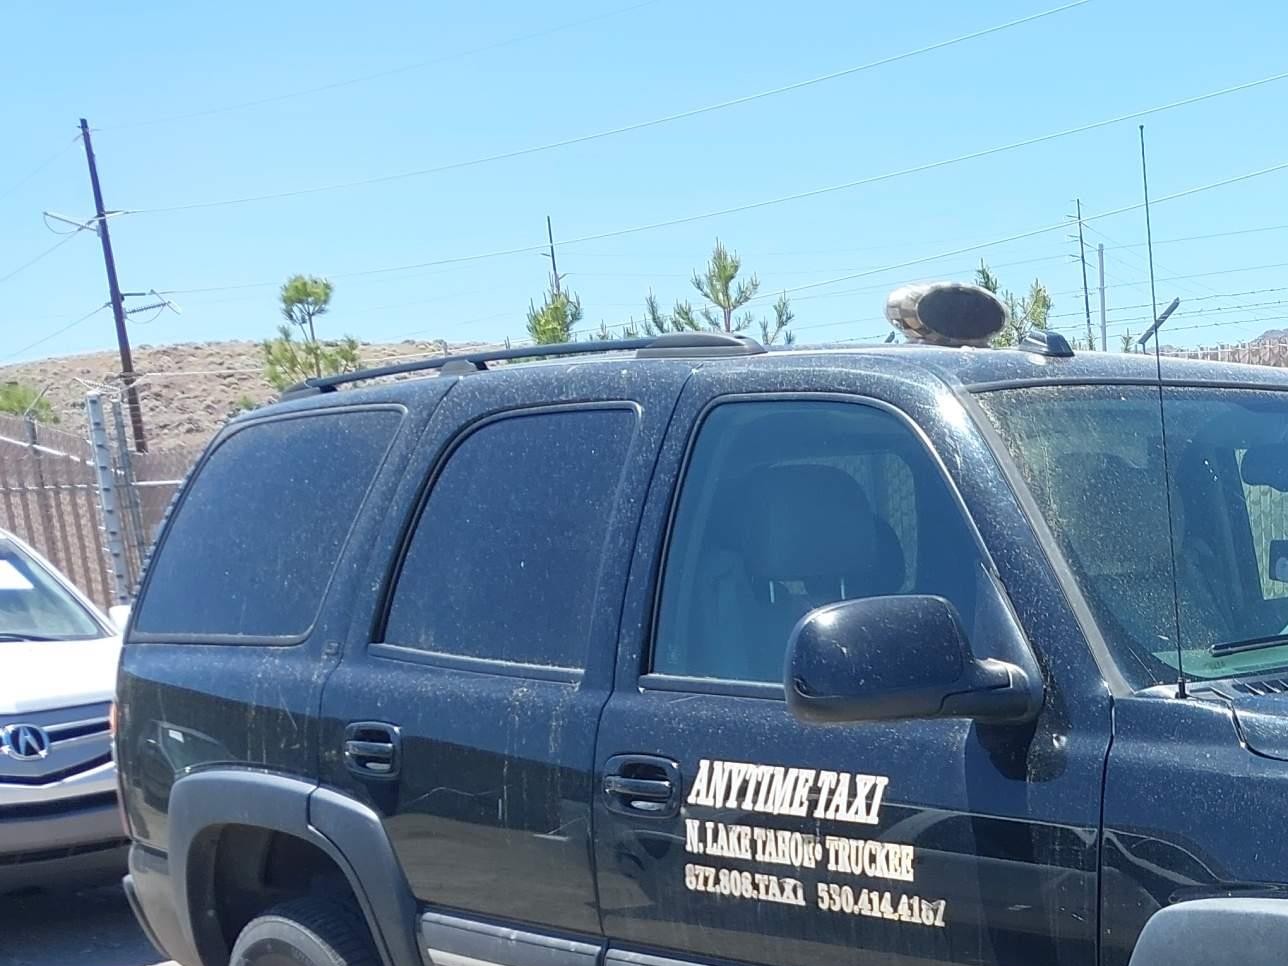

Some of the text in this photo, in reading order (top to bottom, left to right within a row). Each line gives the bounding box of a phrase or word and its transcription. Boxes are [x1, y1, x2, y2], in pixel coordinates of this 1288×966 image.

[687, 760, 889, 825] ANYTIME TAXI
[685, 819, 914, 882] N. LAKE TAHOE TRUCKEE
